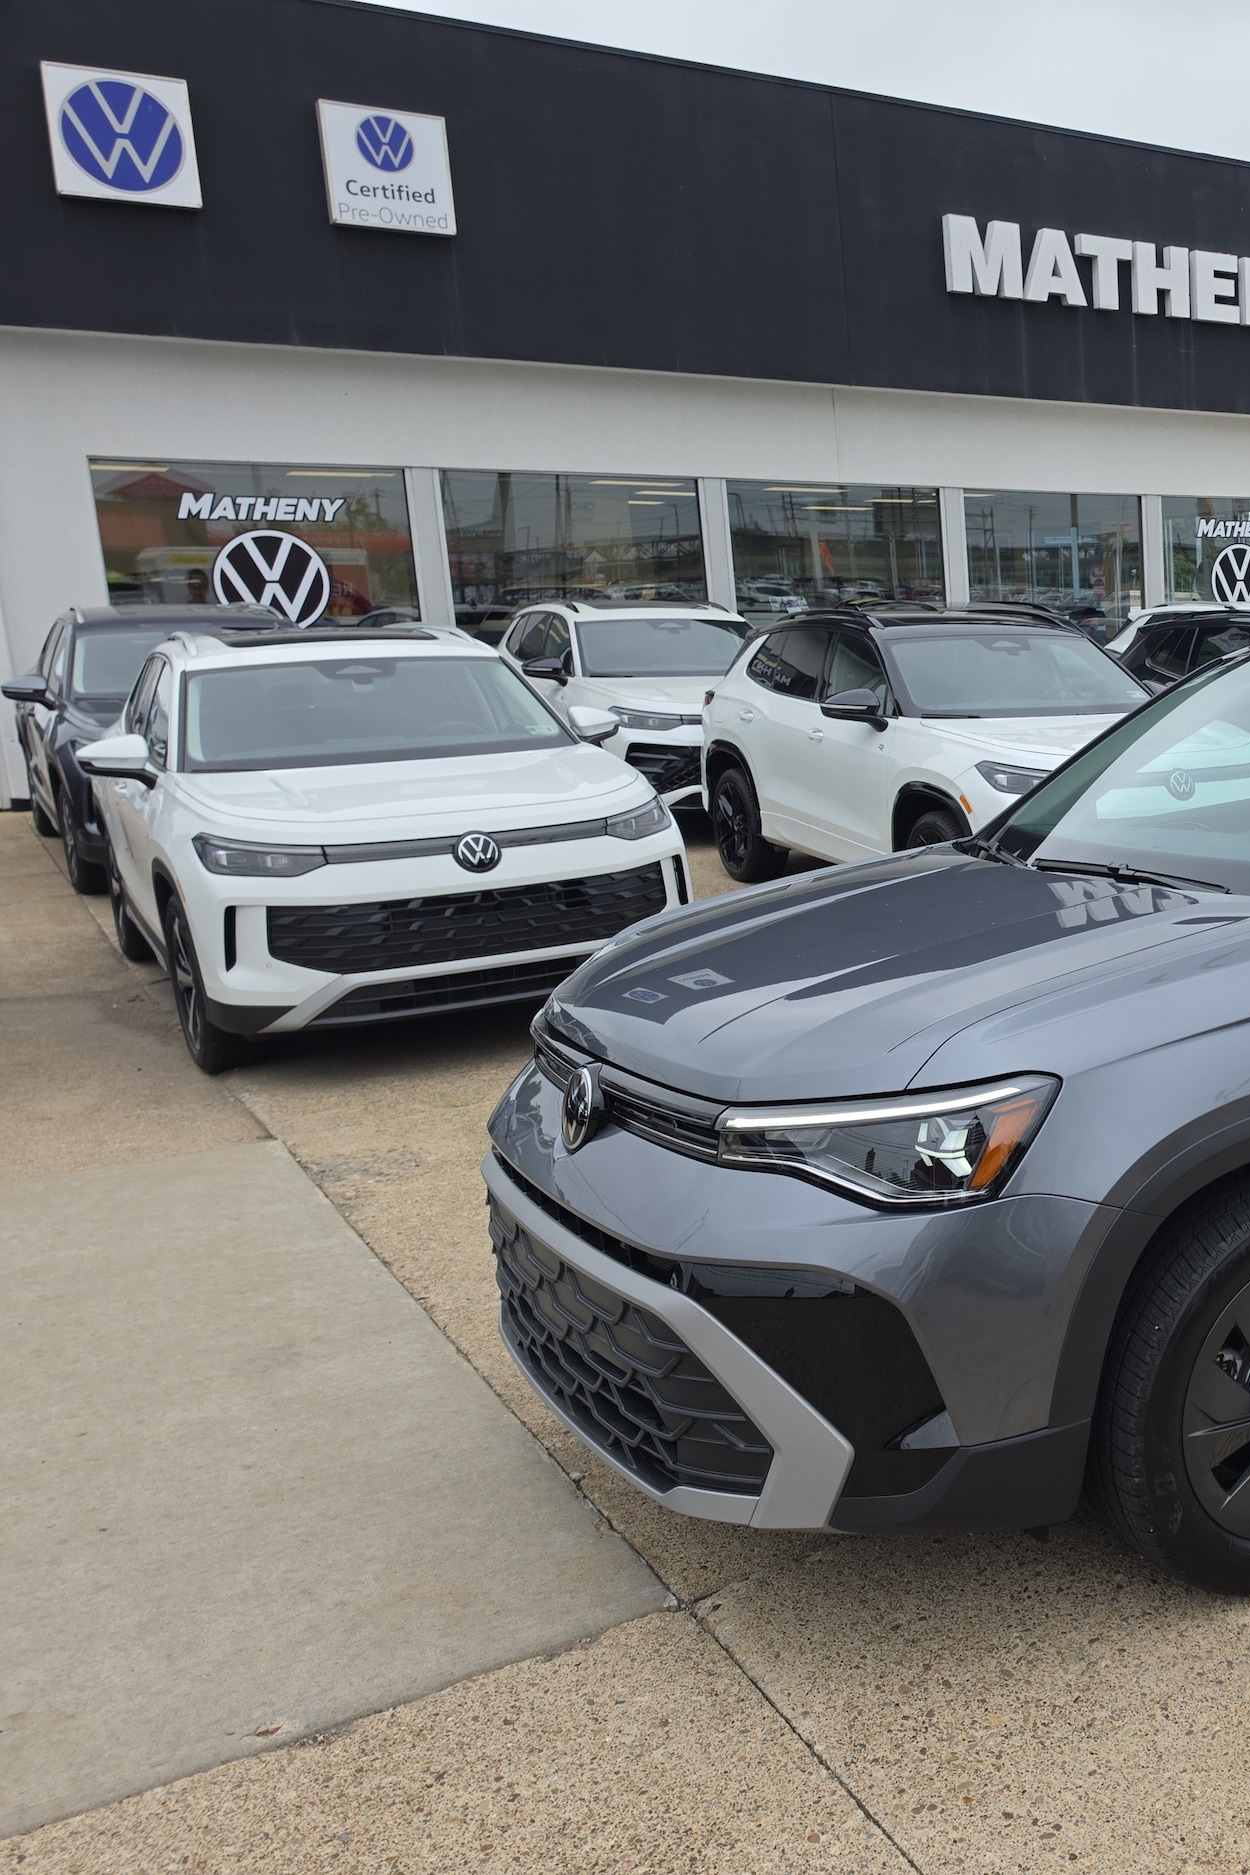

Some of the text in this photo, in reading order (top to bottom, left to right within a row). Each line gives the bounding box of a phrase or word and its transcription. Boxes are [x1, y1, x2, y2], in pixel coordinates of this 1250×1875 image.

[345, 179, 437, 205] Certified
[337, 202, 450, 230] Pre-Owned
[176, 492, 346, 522] MATHENY
